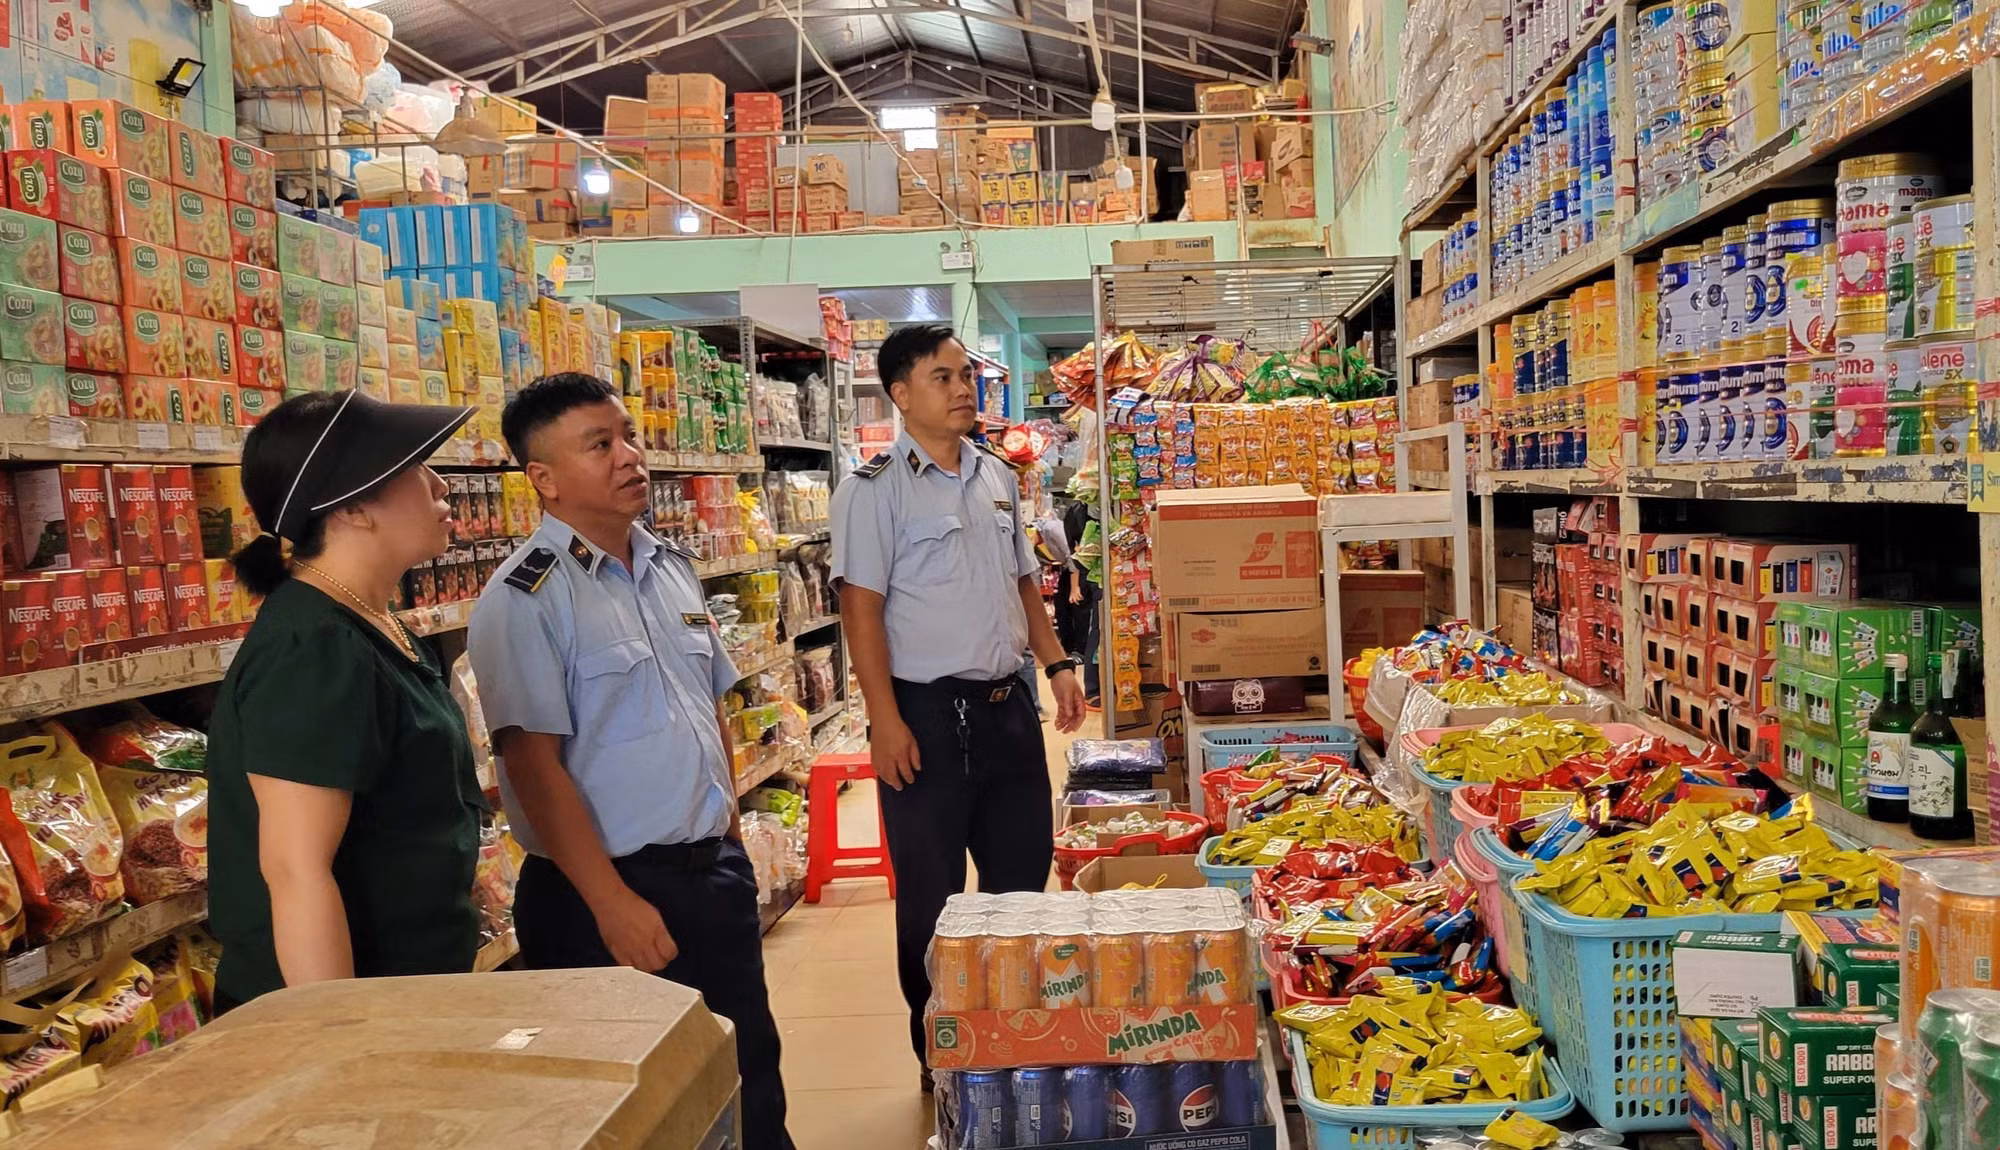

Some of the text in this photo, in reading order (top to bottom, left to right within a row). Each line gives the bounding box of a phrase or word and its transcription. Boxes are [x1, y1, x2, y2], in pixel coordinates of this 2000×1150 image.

[123, 110, 144, 131] Cozy
[34, 118, 48, 150] Cozy
[86, 118, 96, 148] Cozy
[184, 135, 193, 175] Cozy
[233, 147, 253, 167] Cozy
[62, 160, 84, 183] Cozy
[25, 170, 36, 201] Cozy
[129, 180, 149, 202] Cozy
[181, 195, 202, 214] Cozy
[235, 209, 255, 228] Cozy
[67, 232, 90, 254] Cozy
[136, 247, 158, 269] Cozy
[186, 260, 208, 281] Cozy
[240, 271, 260, 288] Cozy
[8, 295, 32, 317] Cozy
[70, 304, 94, 326] Cozy
[138, 312, 158, 333] Cozy
[245, 330, 263, 349] Cozy
[219, 332, 230, 375] Cozy
[6, 368, 31, 389] Cozy
[1944, 368, 1963, 380] 5X
[71, 377, 95, 397] Cozy
[244, 391, 263, 409] Cozy
[1797, 1046, 1806, 1083] ISO 9001
[1823, 1075, 1856, 1085] SUPER
[1827, 1109, 1836, 1146] ISO 9001
[1210, 1136, 1228, 1146] PEPSI
[1229, 1135, 1246, 1144] COLA
